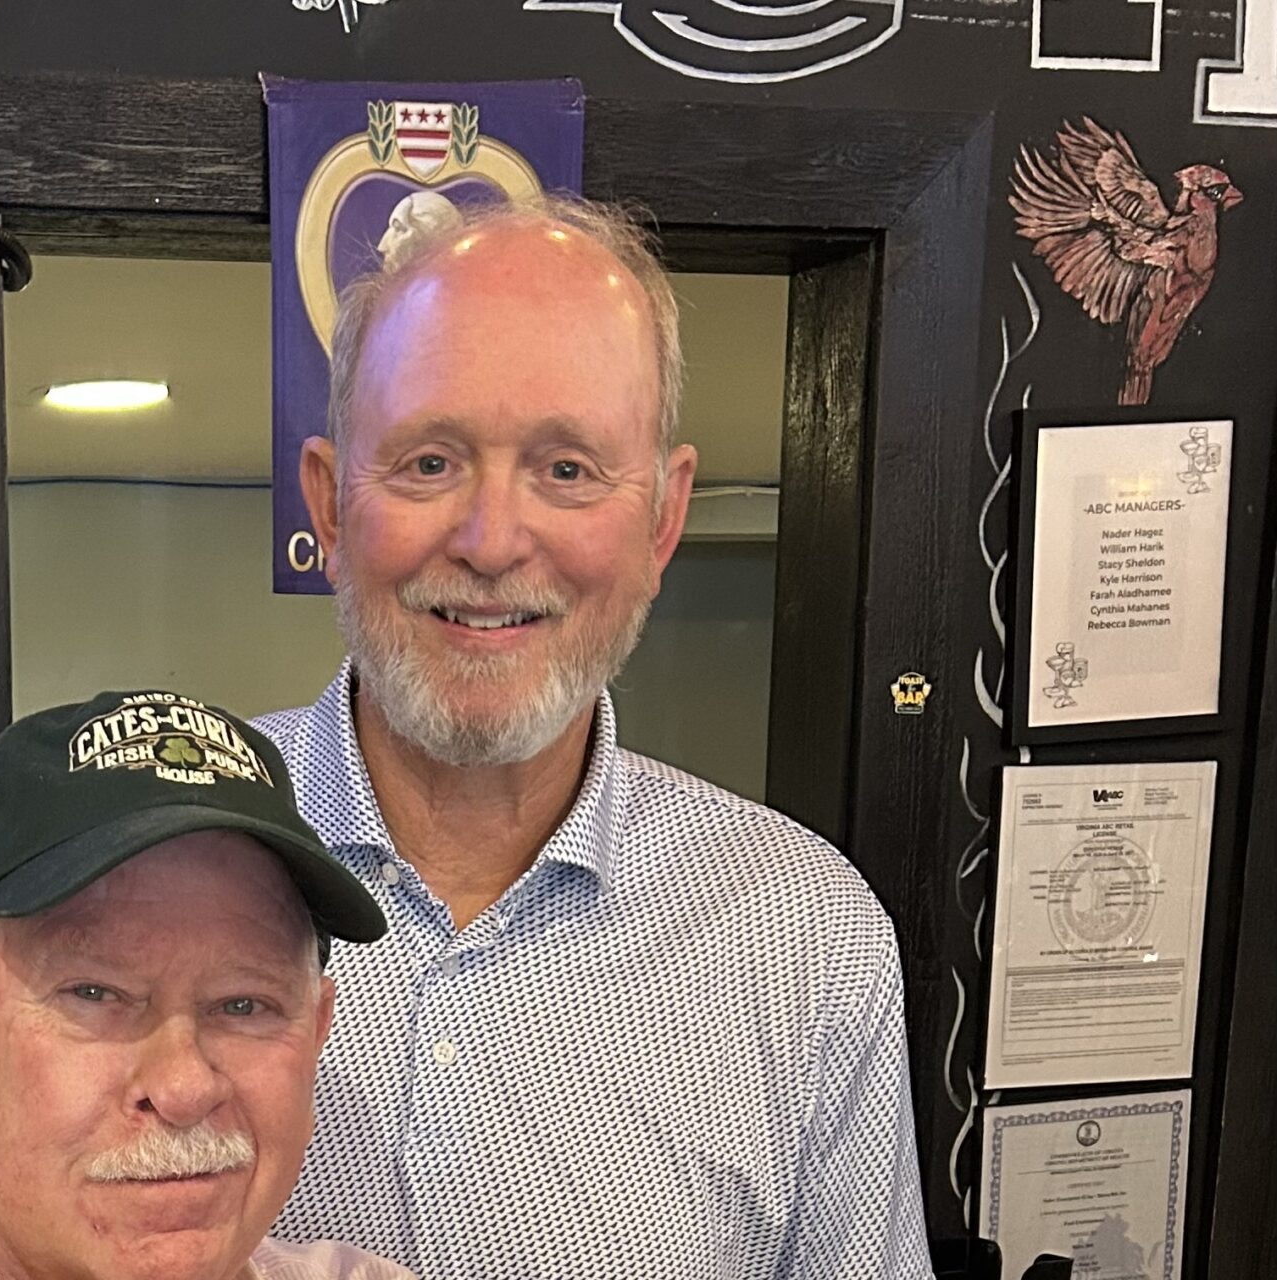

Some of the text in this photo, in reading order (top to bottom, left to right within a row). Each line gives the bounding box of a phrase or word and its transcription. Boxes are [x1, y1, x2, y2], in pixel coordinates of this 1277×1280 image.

[1115, 499, 1185, 513] MANAGERS-
[1102, 529, 1131, 539] Nader
[1100, 545, 1136, 554] William
[1098, 558, 1165, 570] Stacy Sheldon
[1100, 573, 1163, 586] Kyle Harrison
[1090, 590, 1115, 600] Farah
[1090, 603, 1170, 616] Cynthia Mahanes
[1087, 618, 1171, 630] Rebecca Bowman
[95, 744, 256, 782] IRISH PUBLIC
[156, 766, 215, 785] HOUSE
